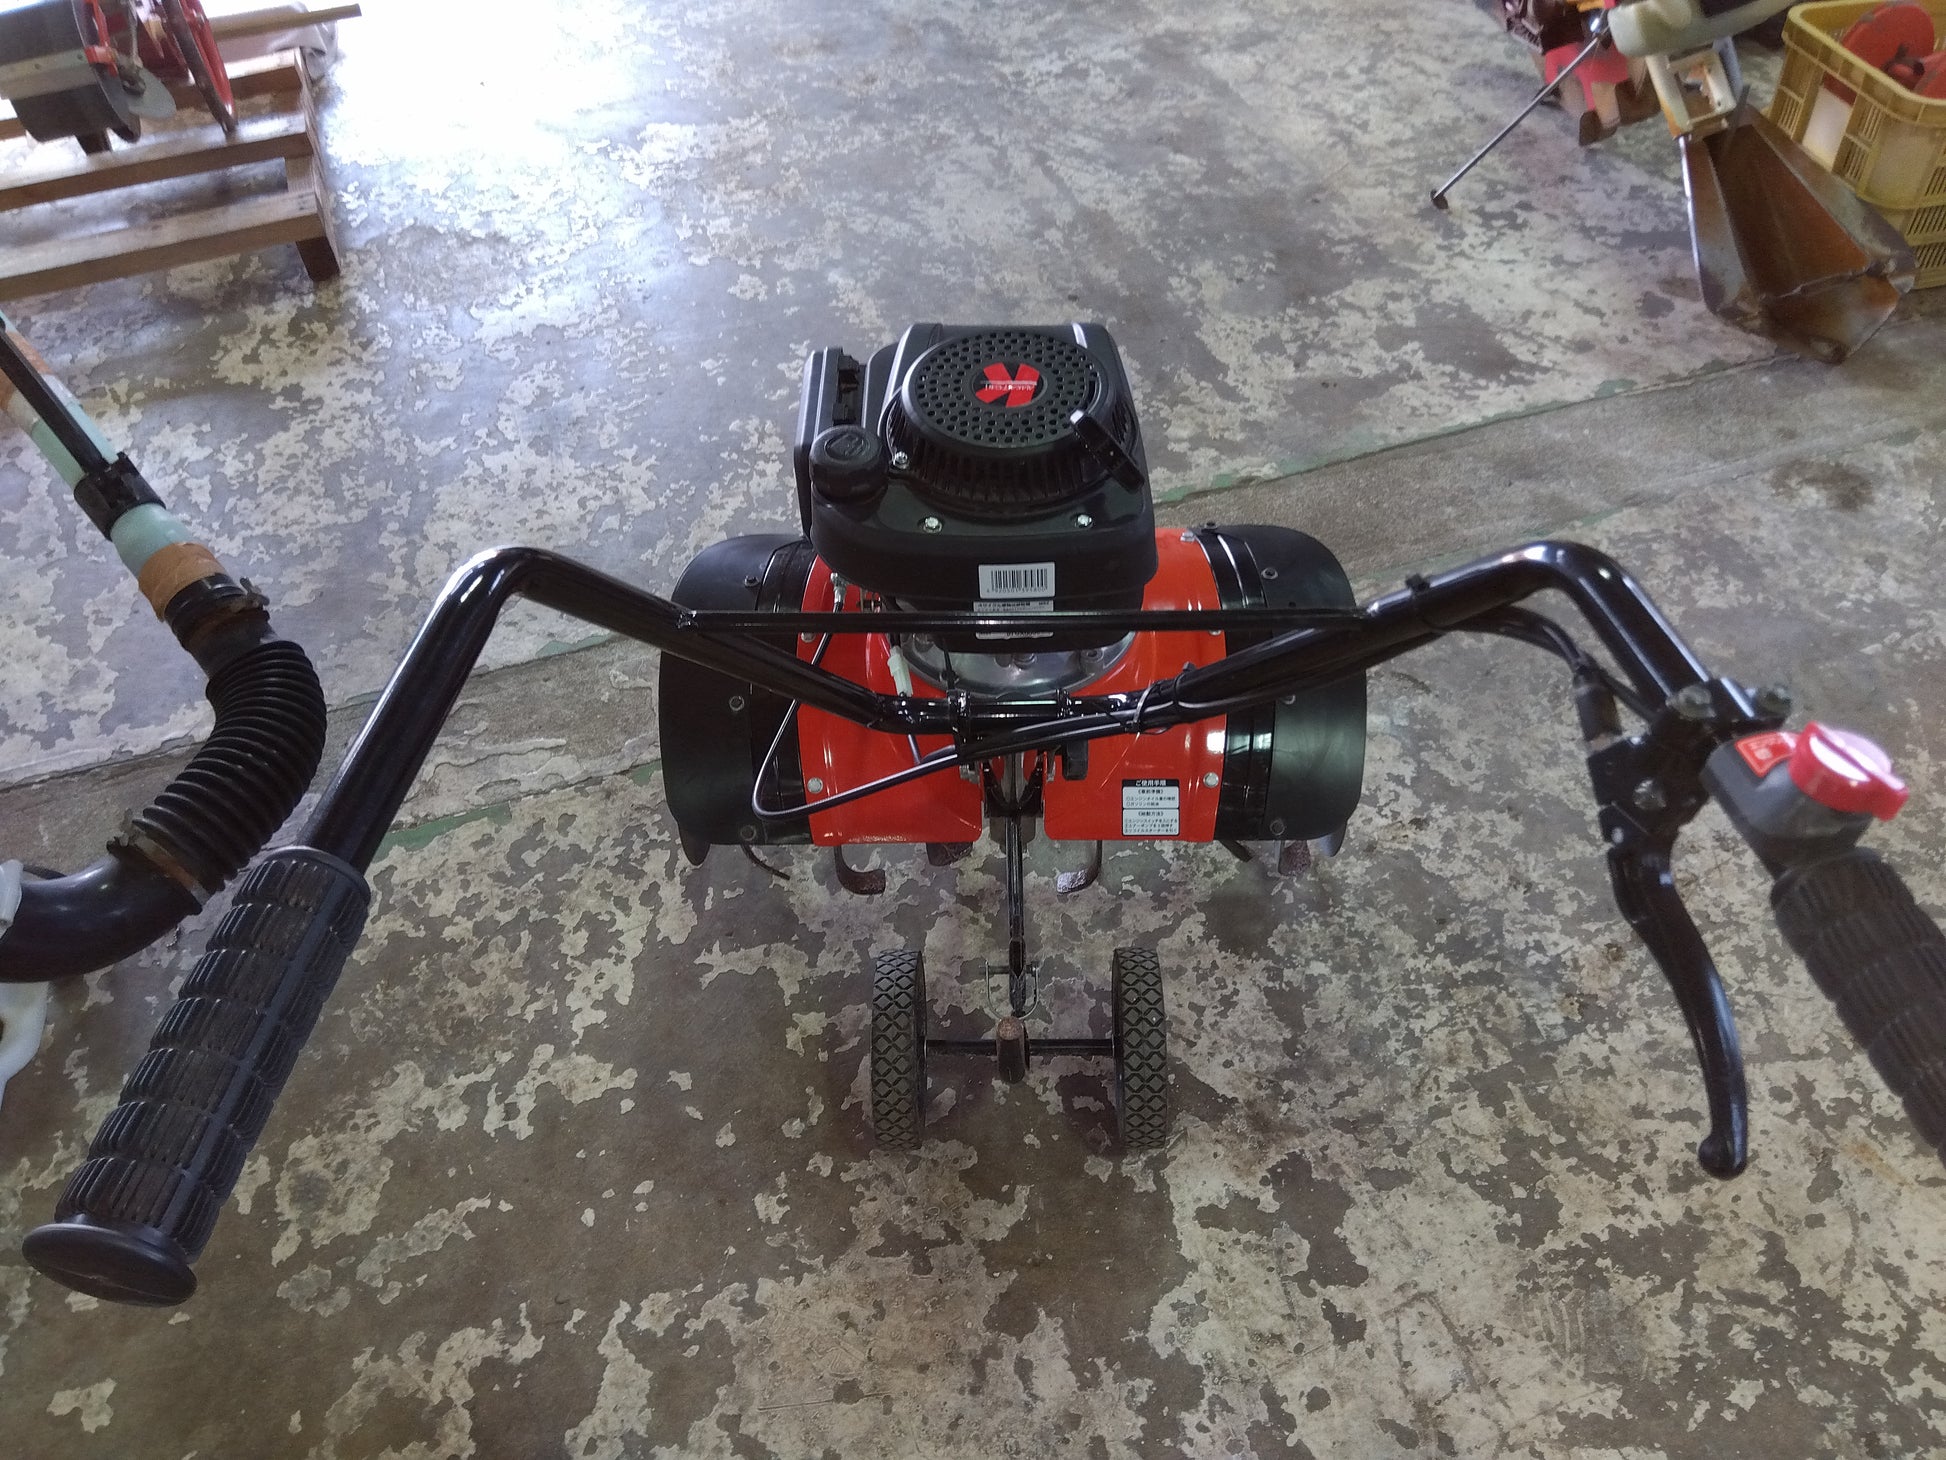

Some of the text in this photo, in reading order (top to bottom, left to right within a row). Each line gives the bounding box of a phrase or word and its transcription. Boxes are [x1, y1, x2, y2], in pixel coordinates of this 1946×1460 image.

[1135, 779, 1167, 787] ご使用手順
